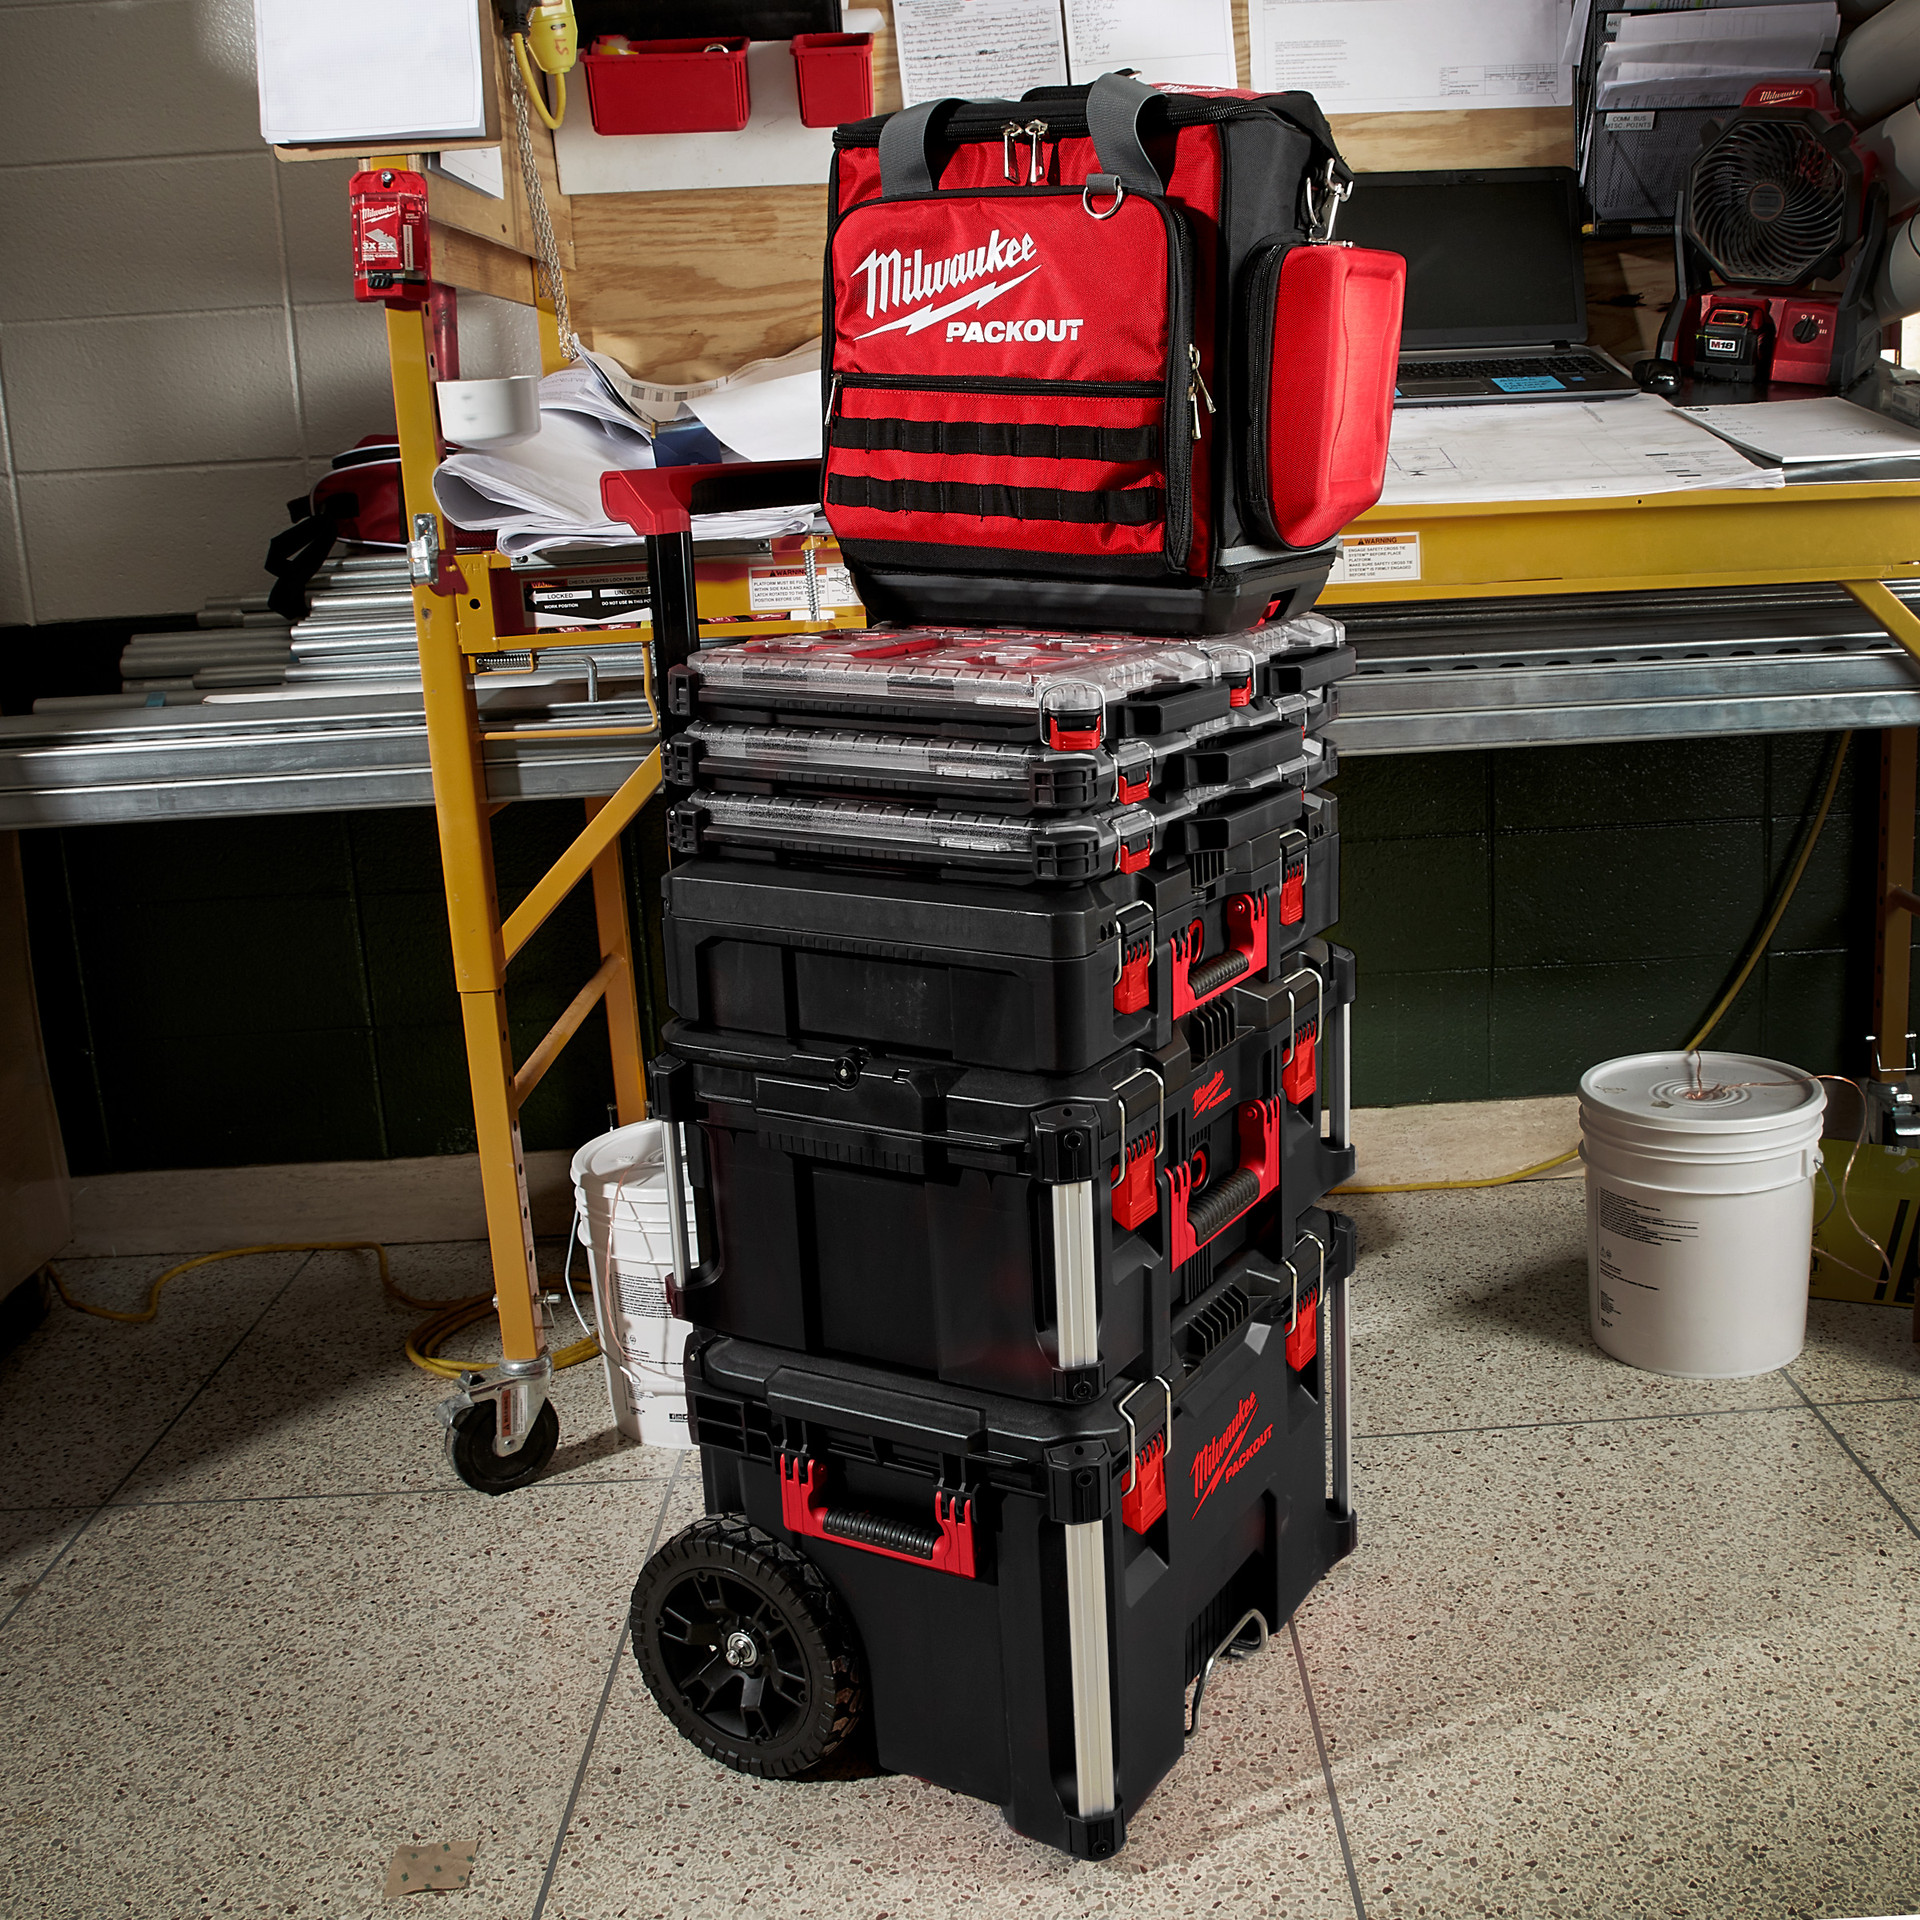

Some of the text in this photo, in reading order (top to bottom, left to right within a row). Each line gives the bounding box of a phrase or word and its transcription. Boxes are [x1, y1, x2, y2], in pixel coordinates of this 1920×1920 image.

[1760, 90, 1804, 101] Milwaukee
[362, 206, 396, 218] Milwaukee
[850, 229, 1037, 320] Milwaukee
[946, 318, 1084, 343] PACKOUT
[1710, 341, 1734, 350] M18
[1189, 1391, 1257, 1498] Milwaukee
[1225, 1423, 1273, 1484] PACKOUT
